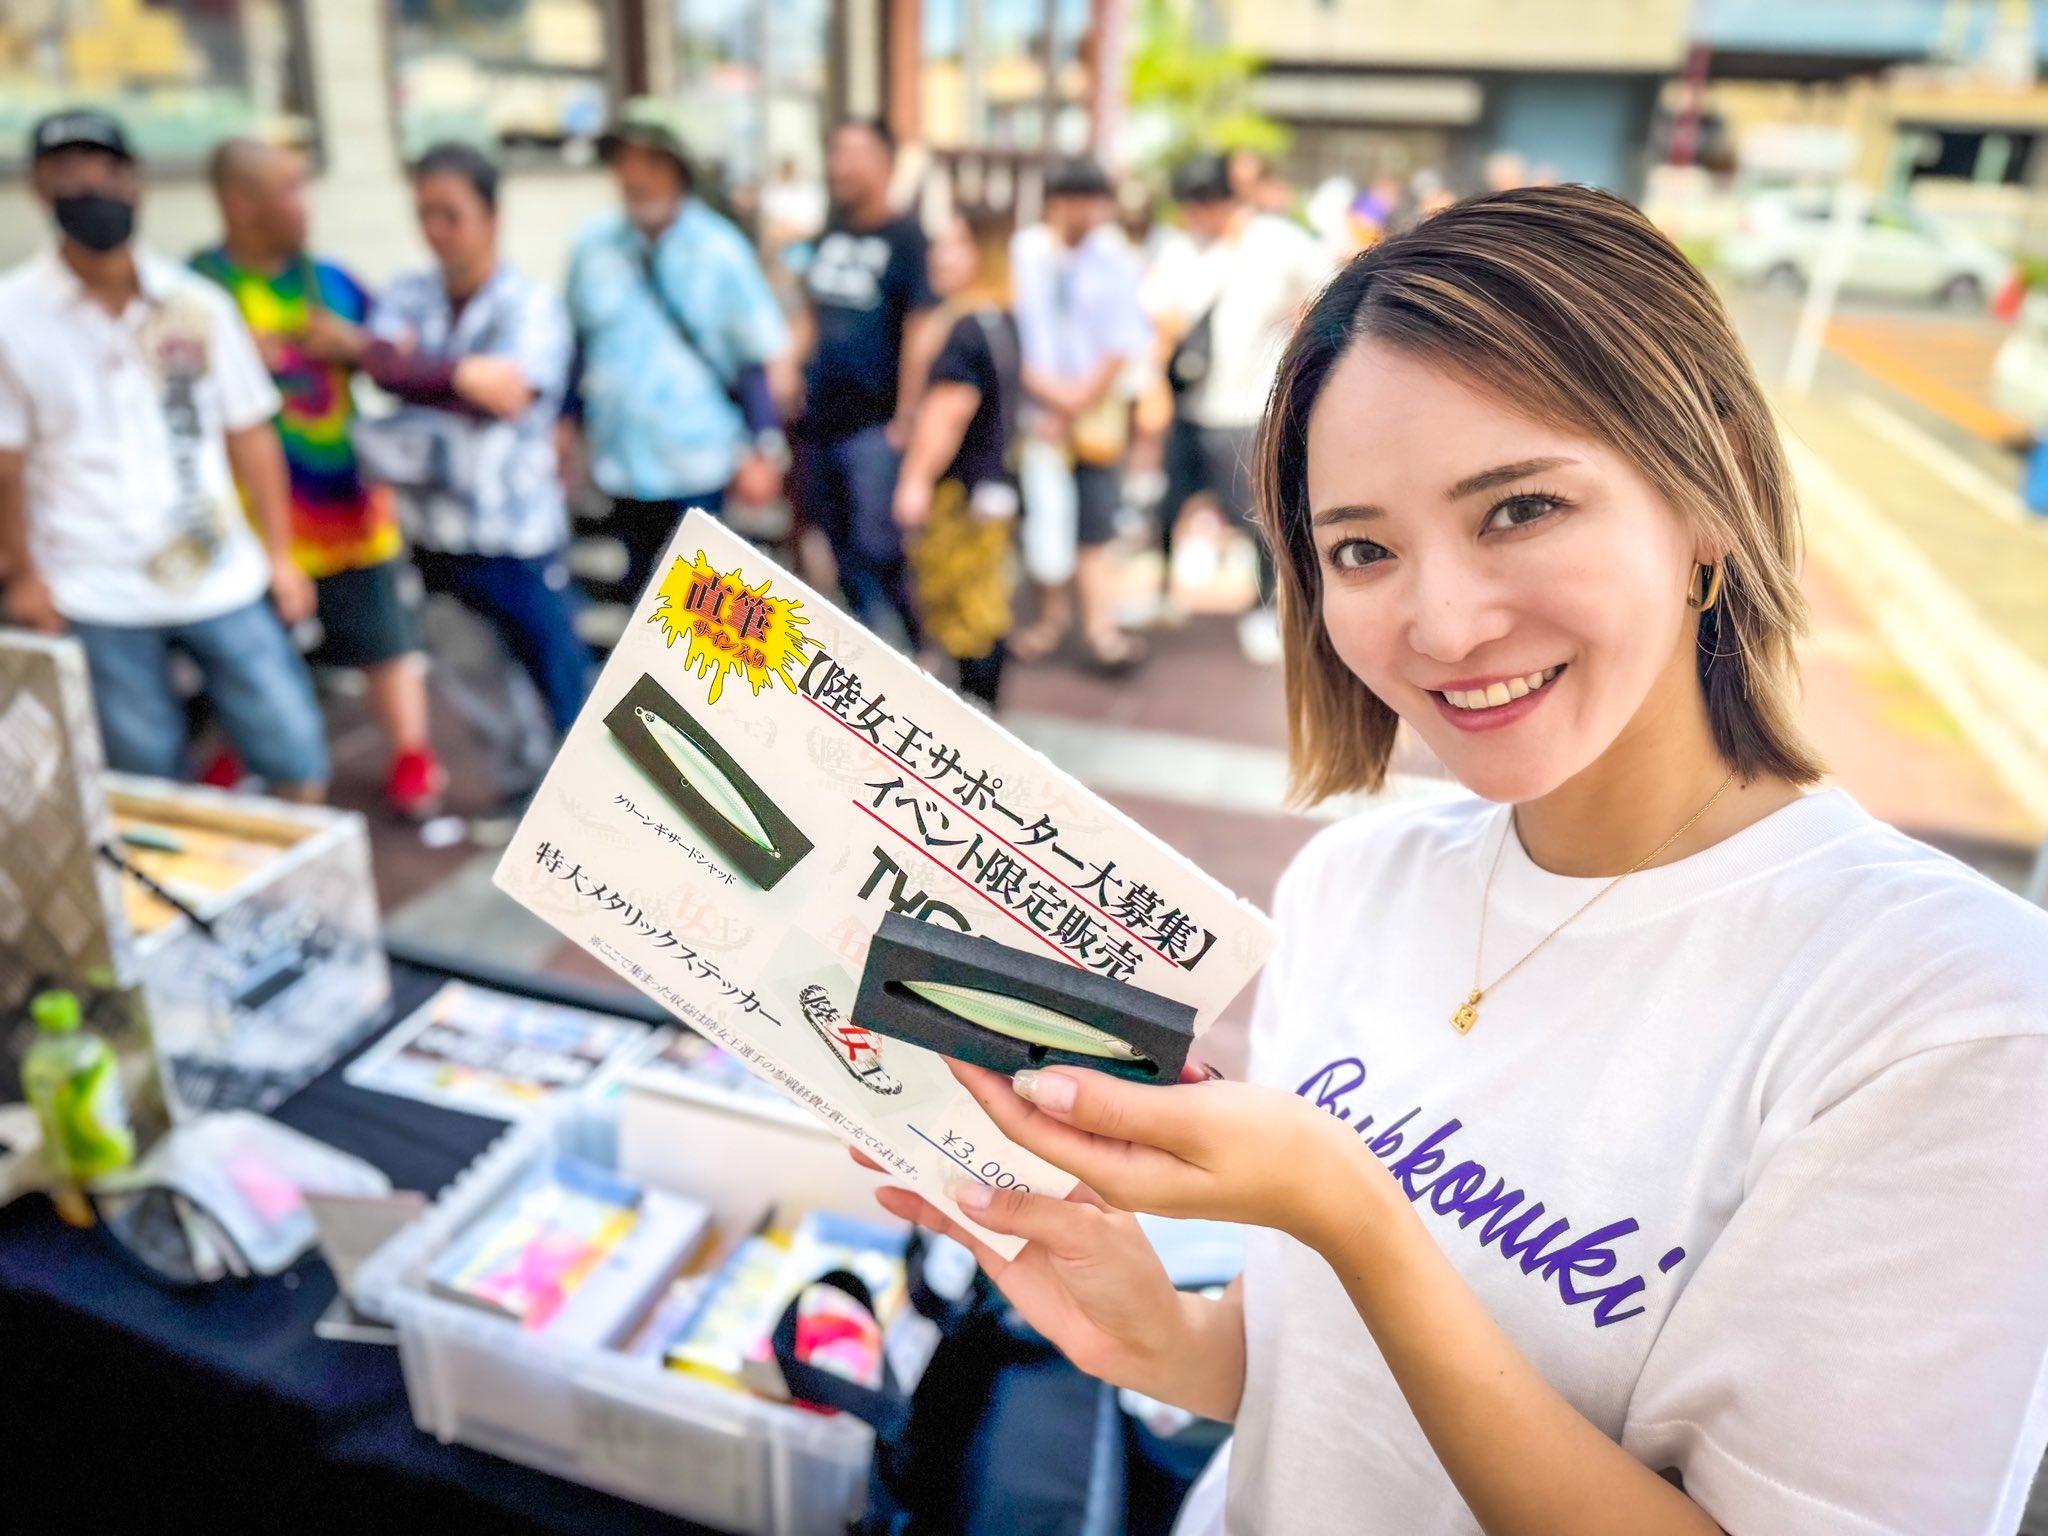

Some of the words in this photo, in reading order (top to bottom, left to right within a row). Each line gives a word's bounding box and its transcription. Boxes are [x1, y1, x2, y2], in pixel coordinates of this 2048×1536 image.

[684, 571, 775, 642] 直筆
[693, 619, 766, 668] サイン入り
[613, 794, 737, 885] グリーンギザードシャッド
[798, 650, 1217, 971] 【陸女王サポーター大募集】
[536, 841, 782, 1027] 特大メタリックステッカー
[864, 777, 1143, 983] イベント限定販売
